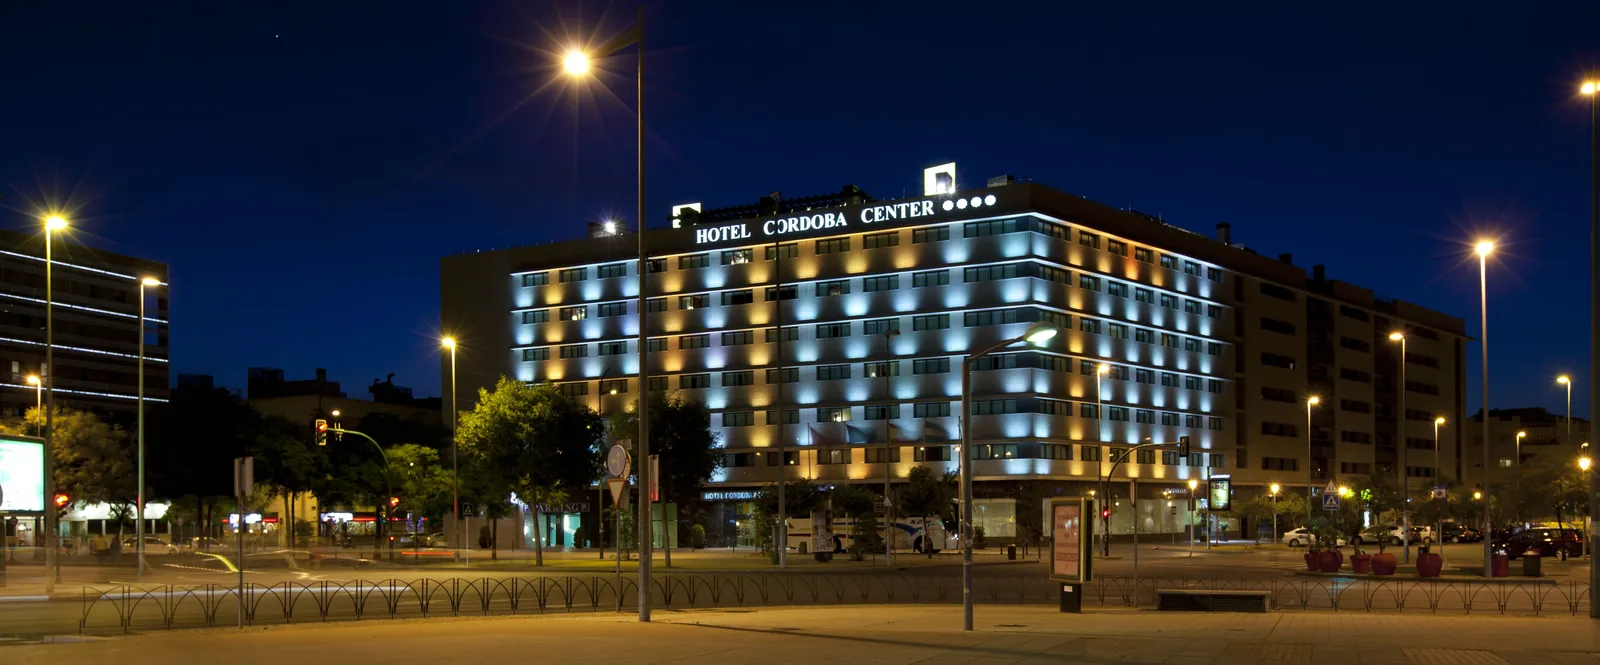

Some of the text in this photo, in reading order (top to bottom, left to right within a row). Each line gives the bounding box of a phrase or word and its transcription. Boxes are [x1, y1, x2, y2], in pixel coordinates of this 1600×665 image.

[696, 200, 935, 244] HOTEL CORDOBA CENTER
